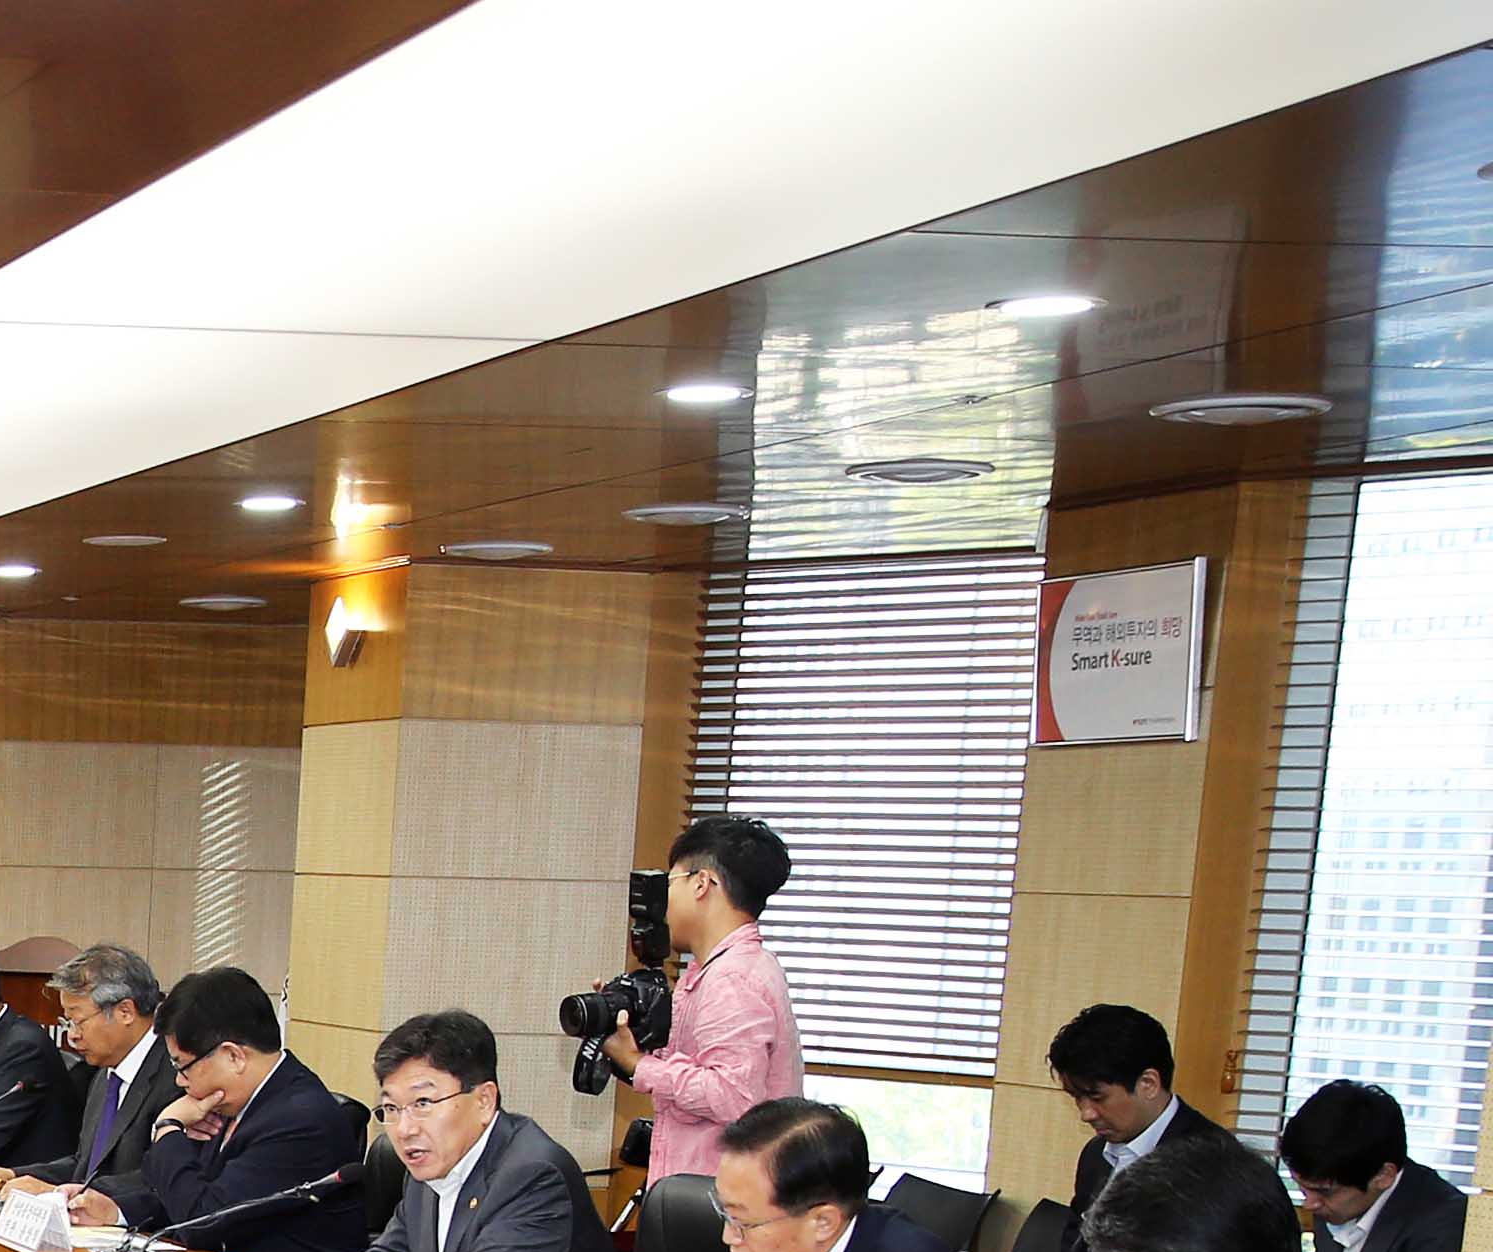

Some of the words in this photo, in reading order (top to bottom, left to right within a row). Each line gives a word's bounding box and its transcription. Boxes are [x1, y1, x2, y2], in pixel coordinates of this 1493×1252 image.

[1072, 624, 1102, 646] 무역과
[1106, 619, 1157, 642] 해외투자의
[1161, 616, 1182, 640] 희망
[1071, 652, 1109, 671] Smart
[1111, 648, 1152, 668] K-sure
